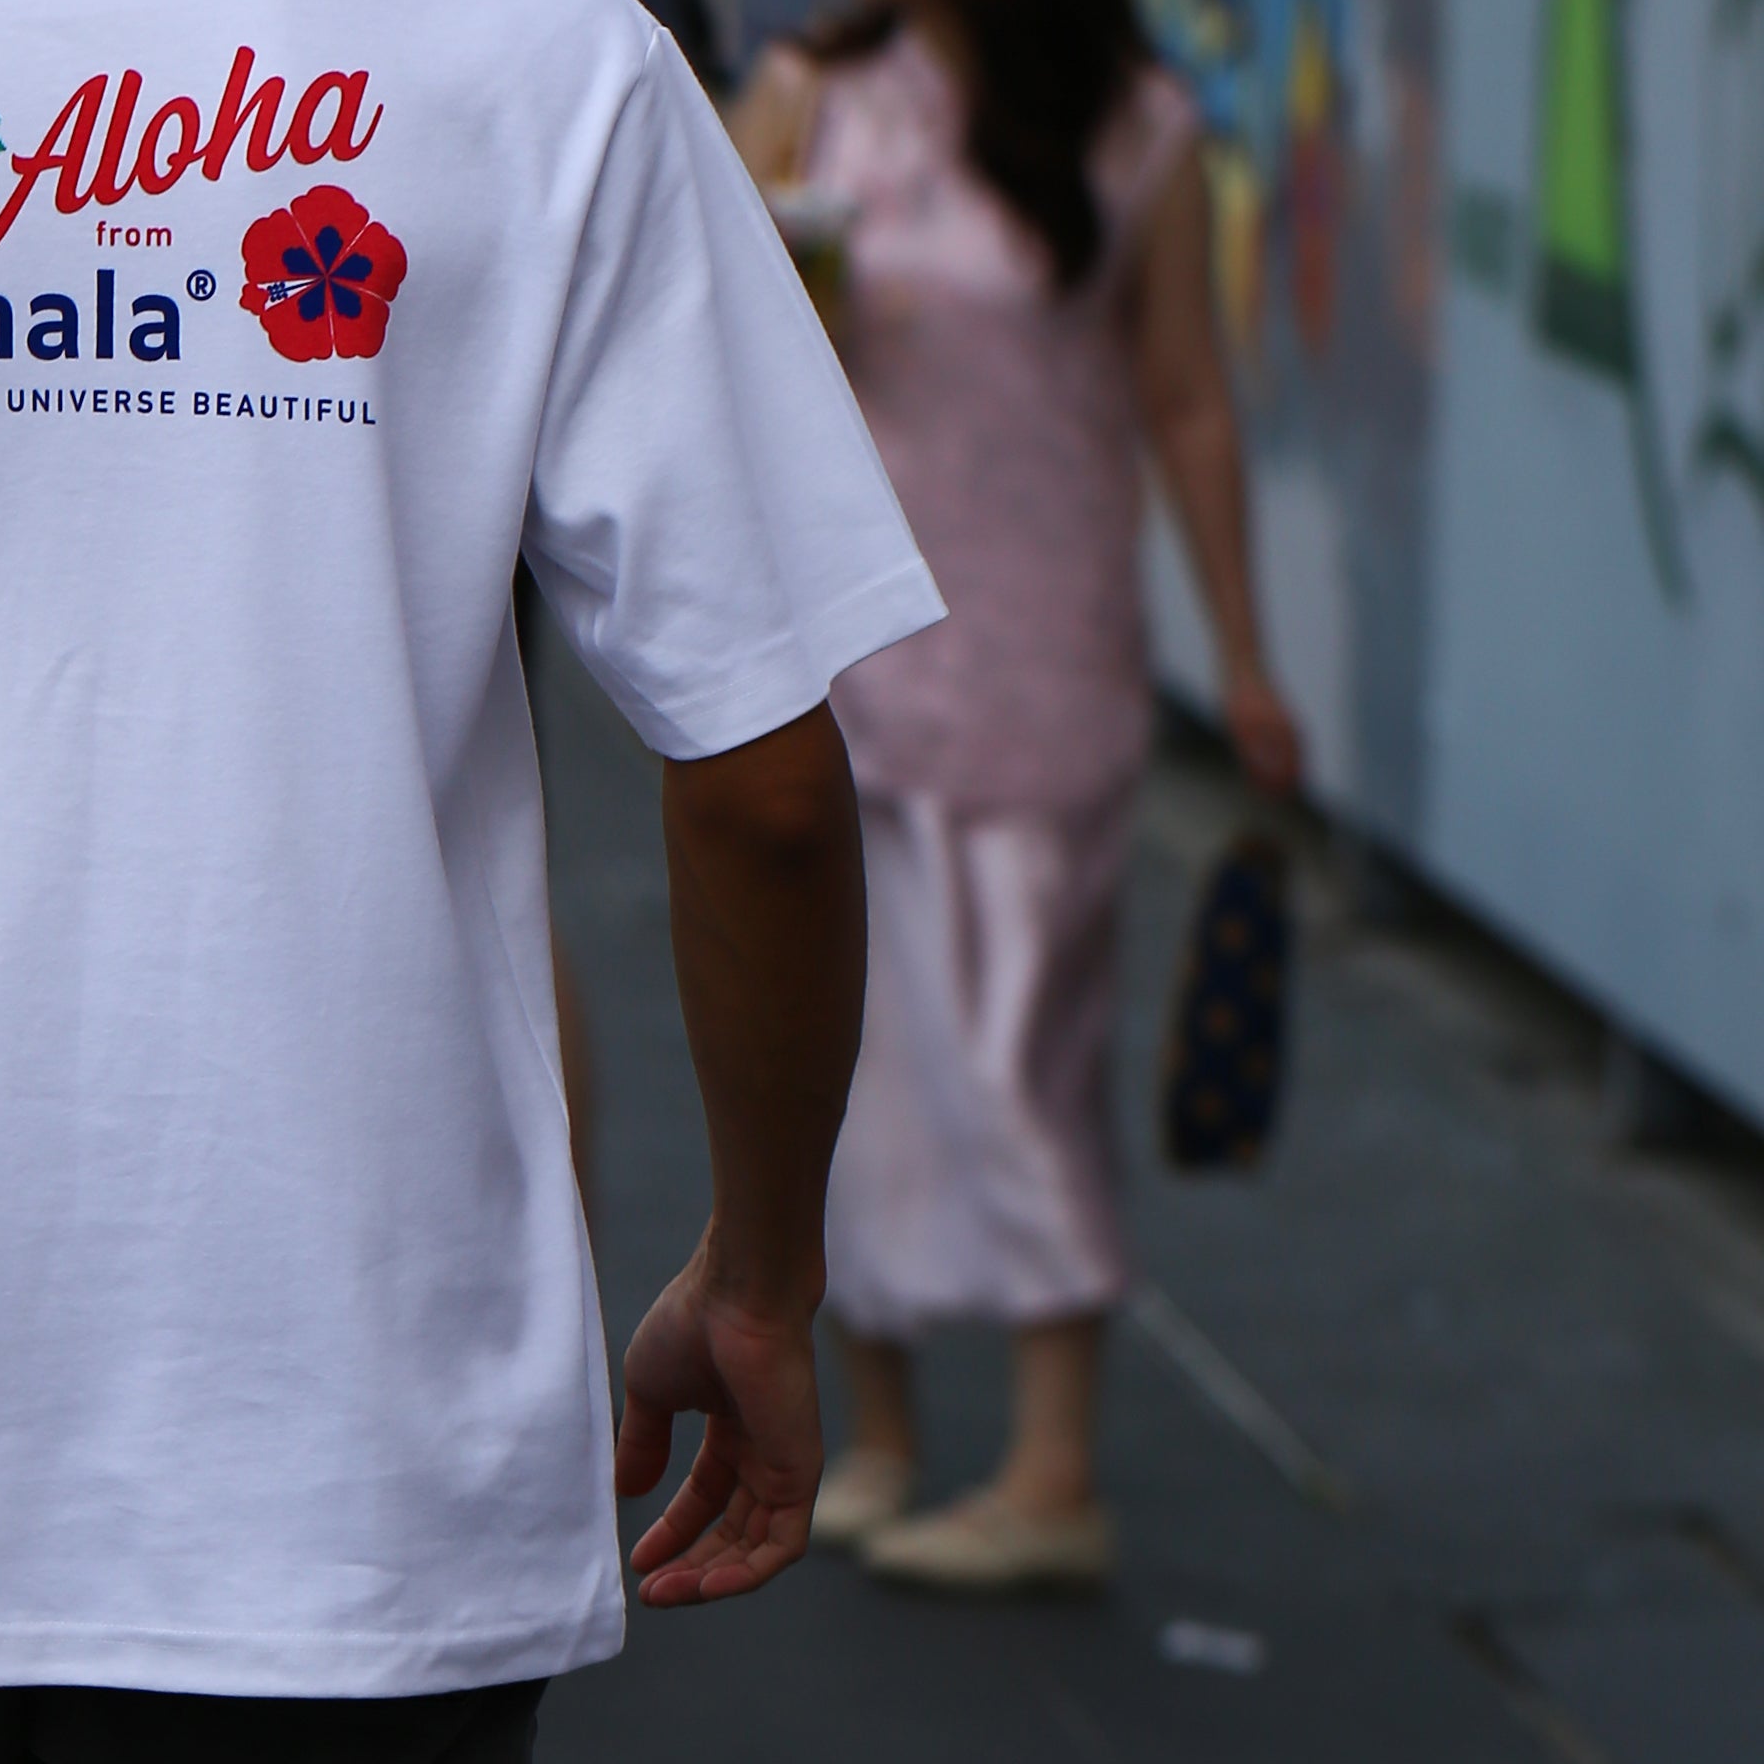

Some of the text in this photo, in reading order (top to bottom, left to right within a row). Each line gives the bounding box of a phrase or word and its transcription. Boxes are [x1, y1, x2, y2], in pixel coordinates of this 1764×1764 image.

[96, 220, 172, 247] from
[7, 388, 176, 415] UNIVERSE
[193, 391, 377, 426] BEAUTIFUL
